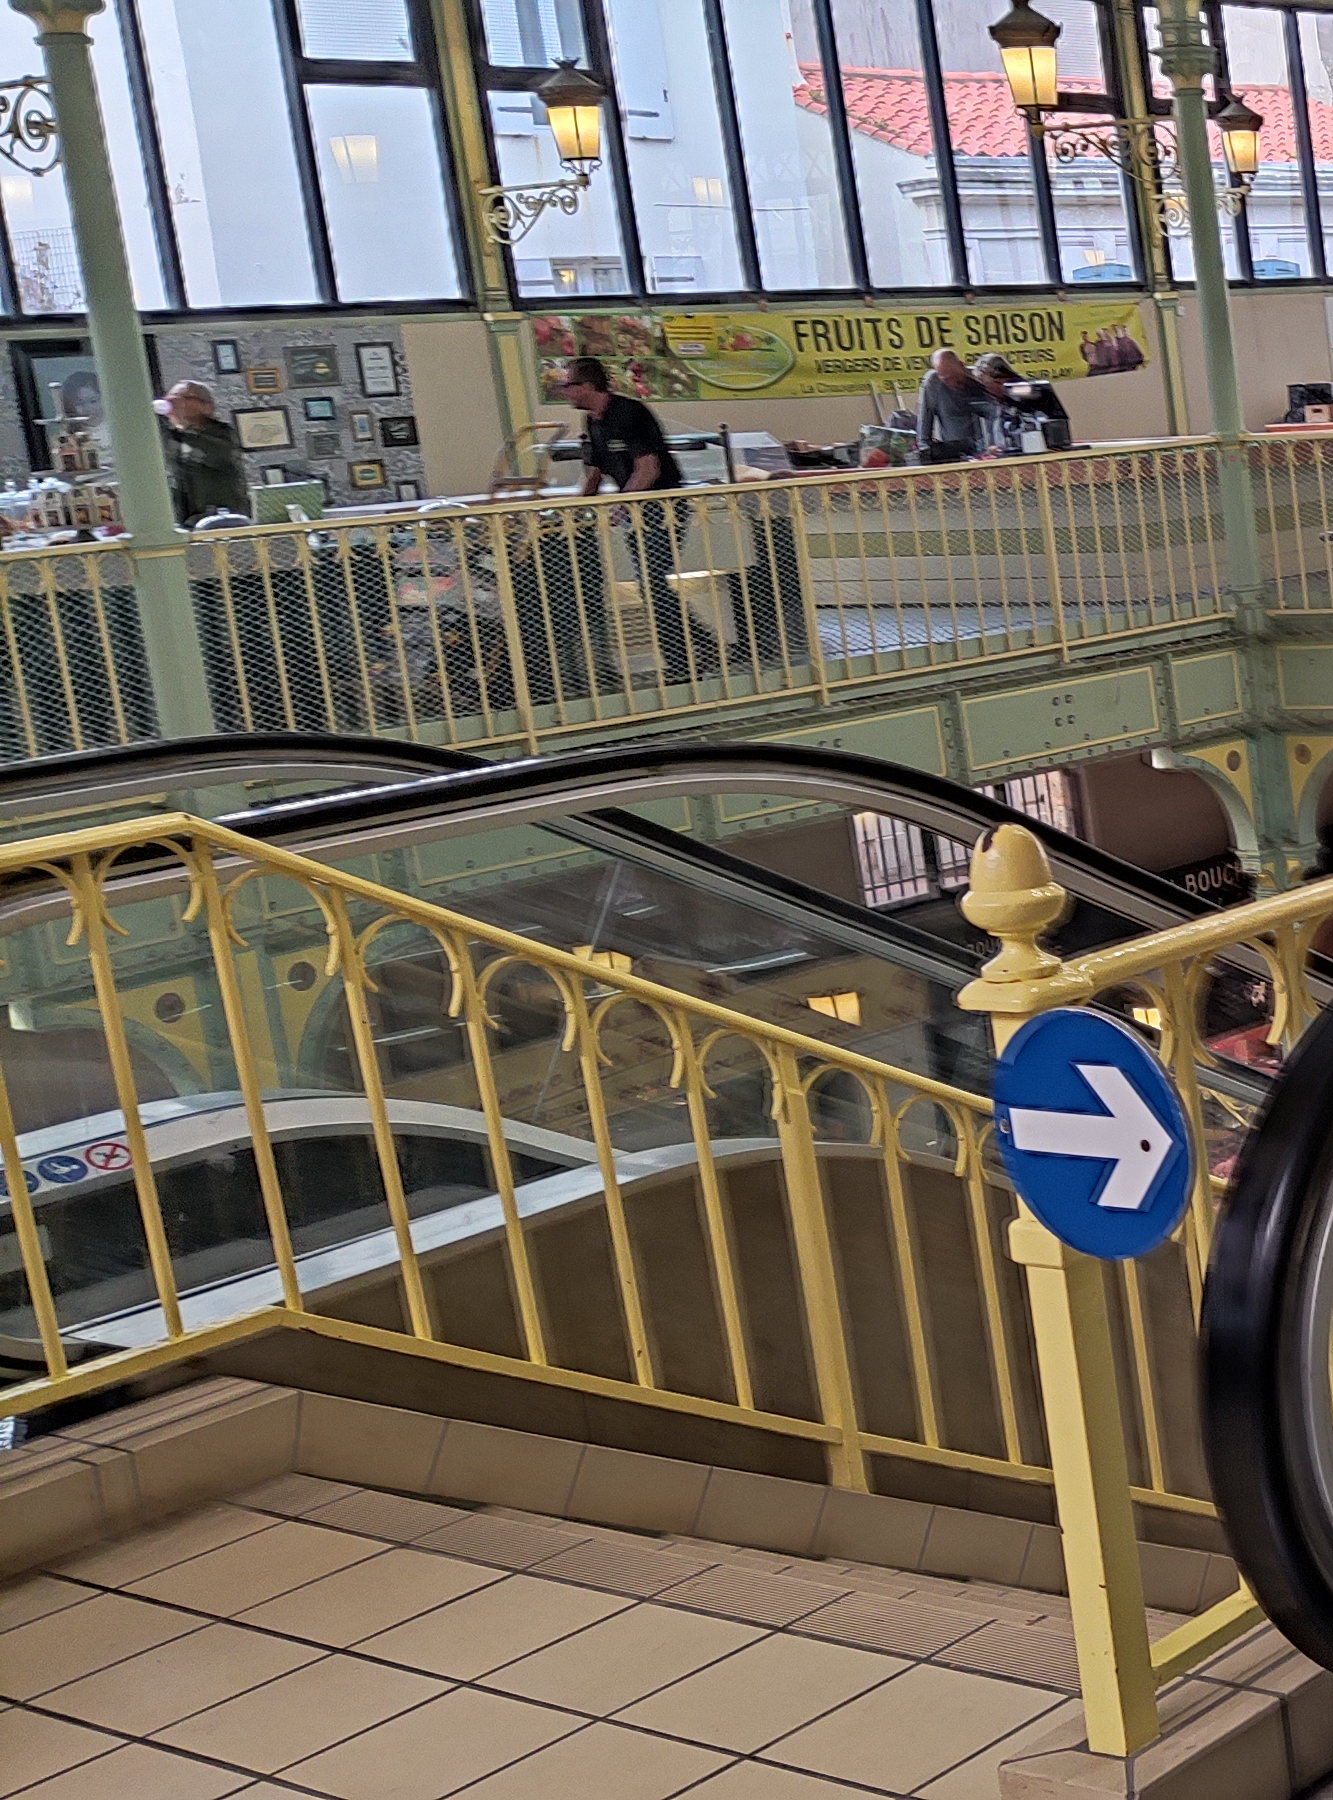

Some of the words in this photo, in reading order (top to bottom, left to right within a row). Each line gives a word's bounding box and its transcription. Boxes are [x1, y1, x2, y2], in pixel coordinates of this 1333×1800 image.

[792, 316, 905, 353] FRUITS
[915, 315, 956, 349] DE
[963, 311, 1066, 347] SAISON
[815, 356, 881, 374] VERGERS
[882, 355, 903, 371] DE
